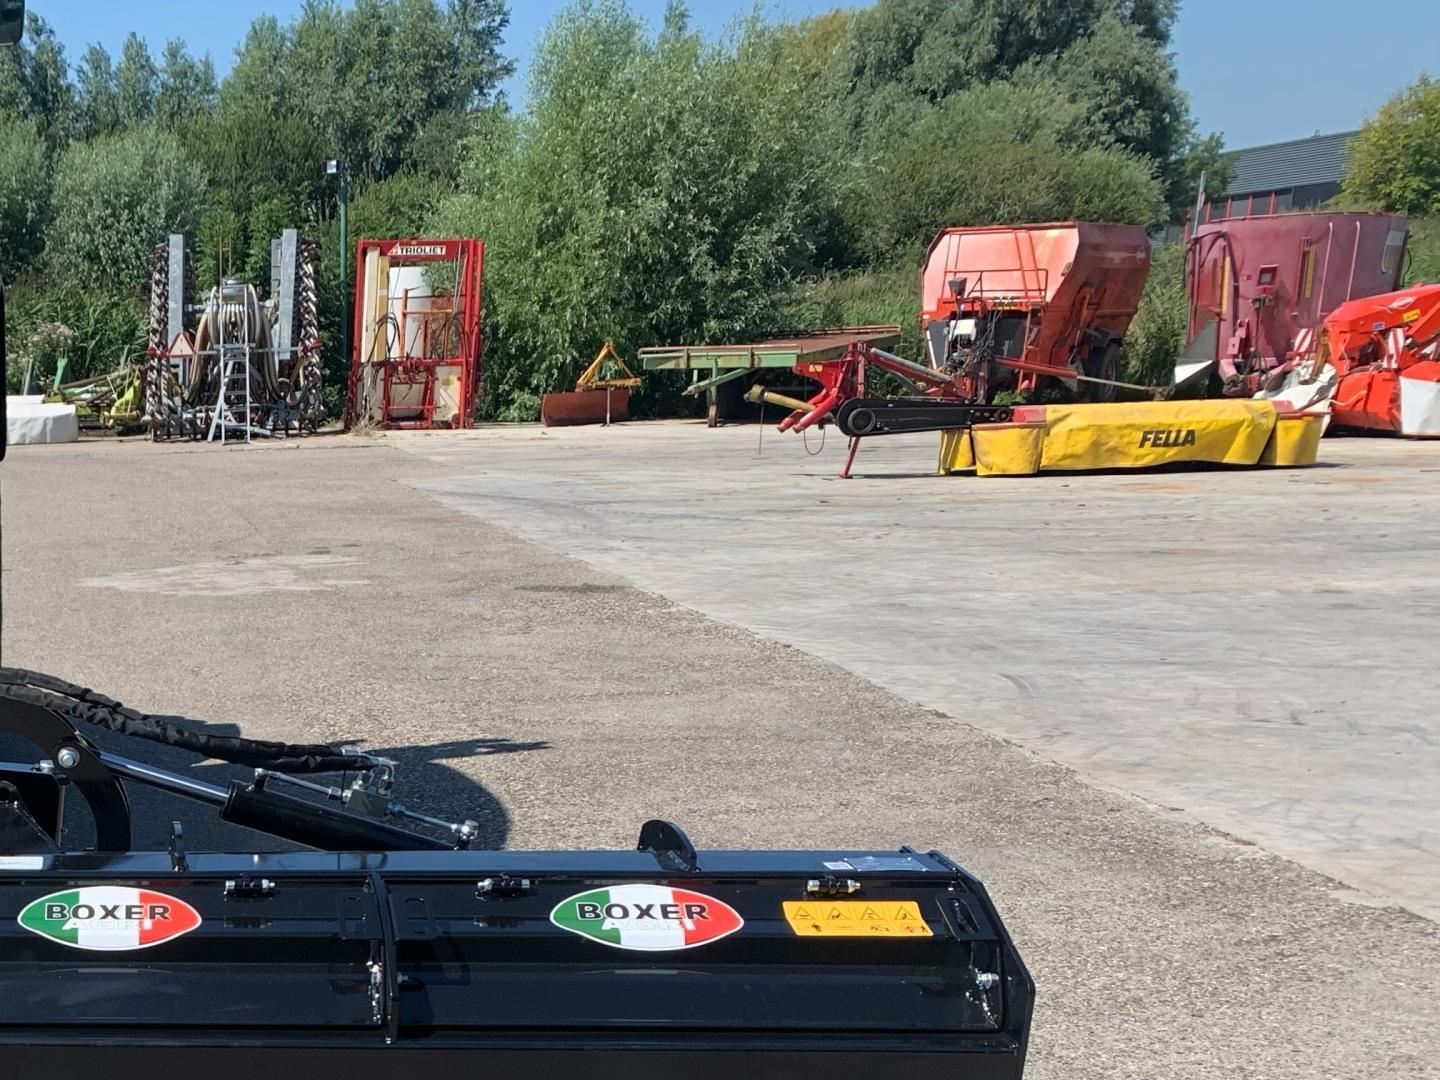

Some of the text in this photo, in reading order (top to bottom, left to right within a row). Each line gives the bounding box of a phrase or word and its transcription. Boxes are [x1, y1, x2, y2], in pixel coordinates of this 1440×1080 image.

[400, 246, 445, 255] TRIOLIET
[1138, 429, 1196, 448] FELLA
[46, 903, 170, 920] BOXER
[576, 903, 710, 920] BOXER
